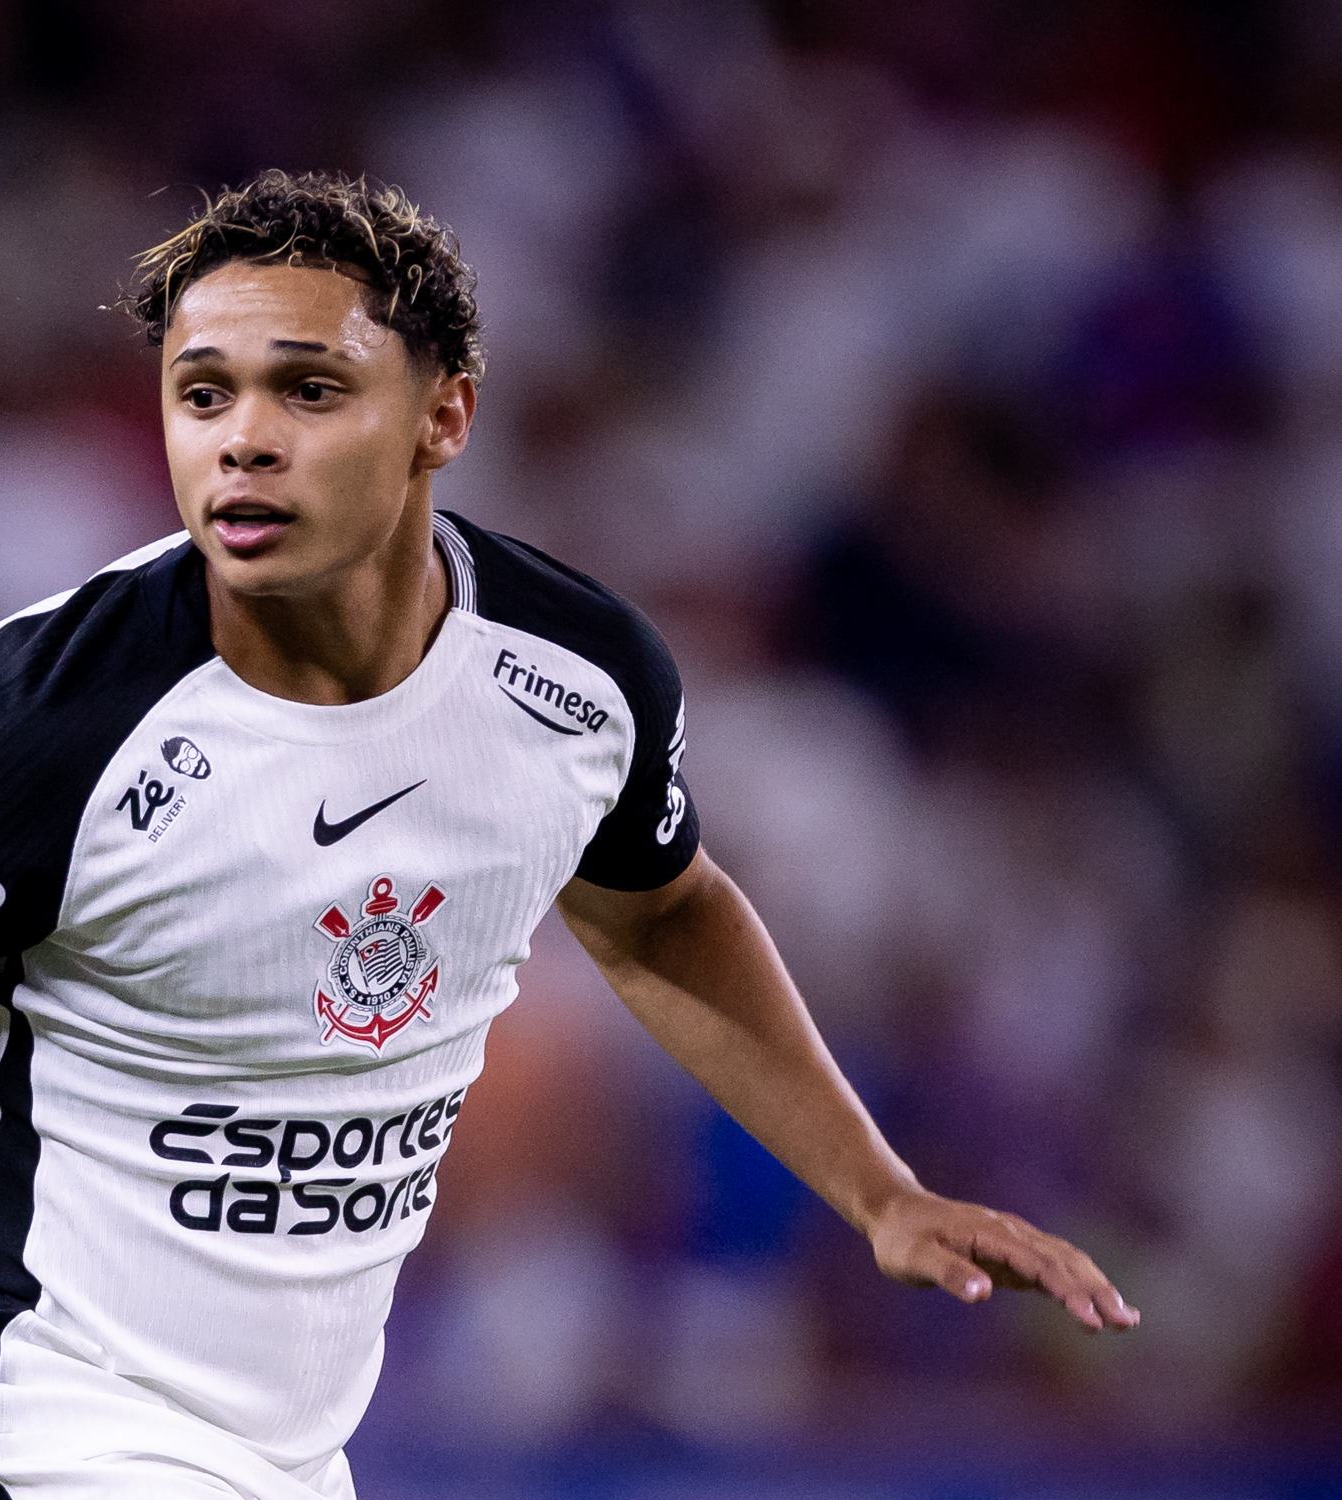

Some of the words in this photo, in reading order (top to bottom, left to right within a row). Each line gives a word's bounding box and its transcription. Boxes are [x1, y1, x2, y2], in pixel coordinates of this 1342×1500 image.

[493, 648, 610, 734] Frimesa
[115, 769, 175, 831] Zé
[148, 795, 187, 843] DELIVERY
[339, 922, 401, 976] CORINTHIANS
[400, 928, 417, 985] PAULISTA
[366, 993, 393, 1006] 1910
[149, 1087, 466, 1184] Esportes
